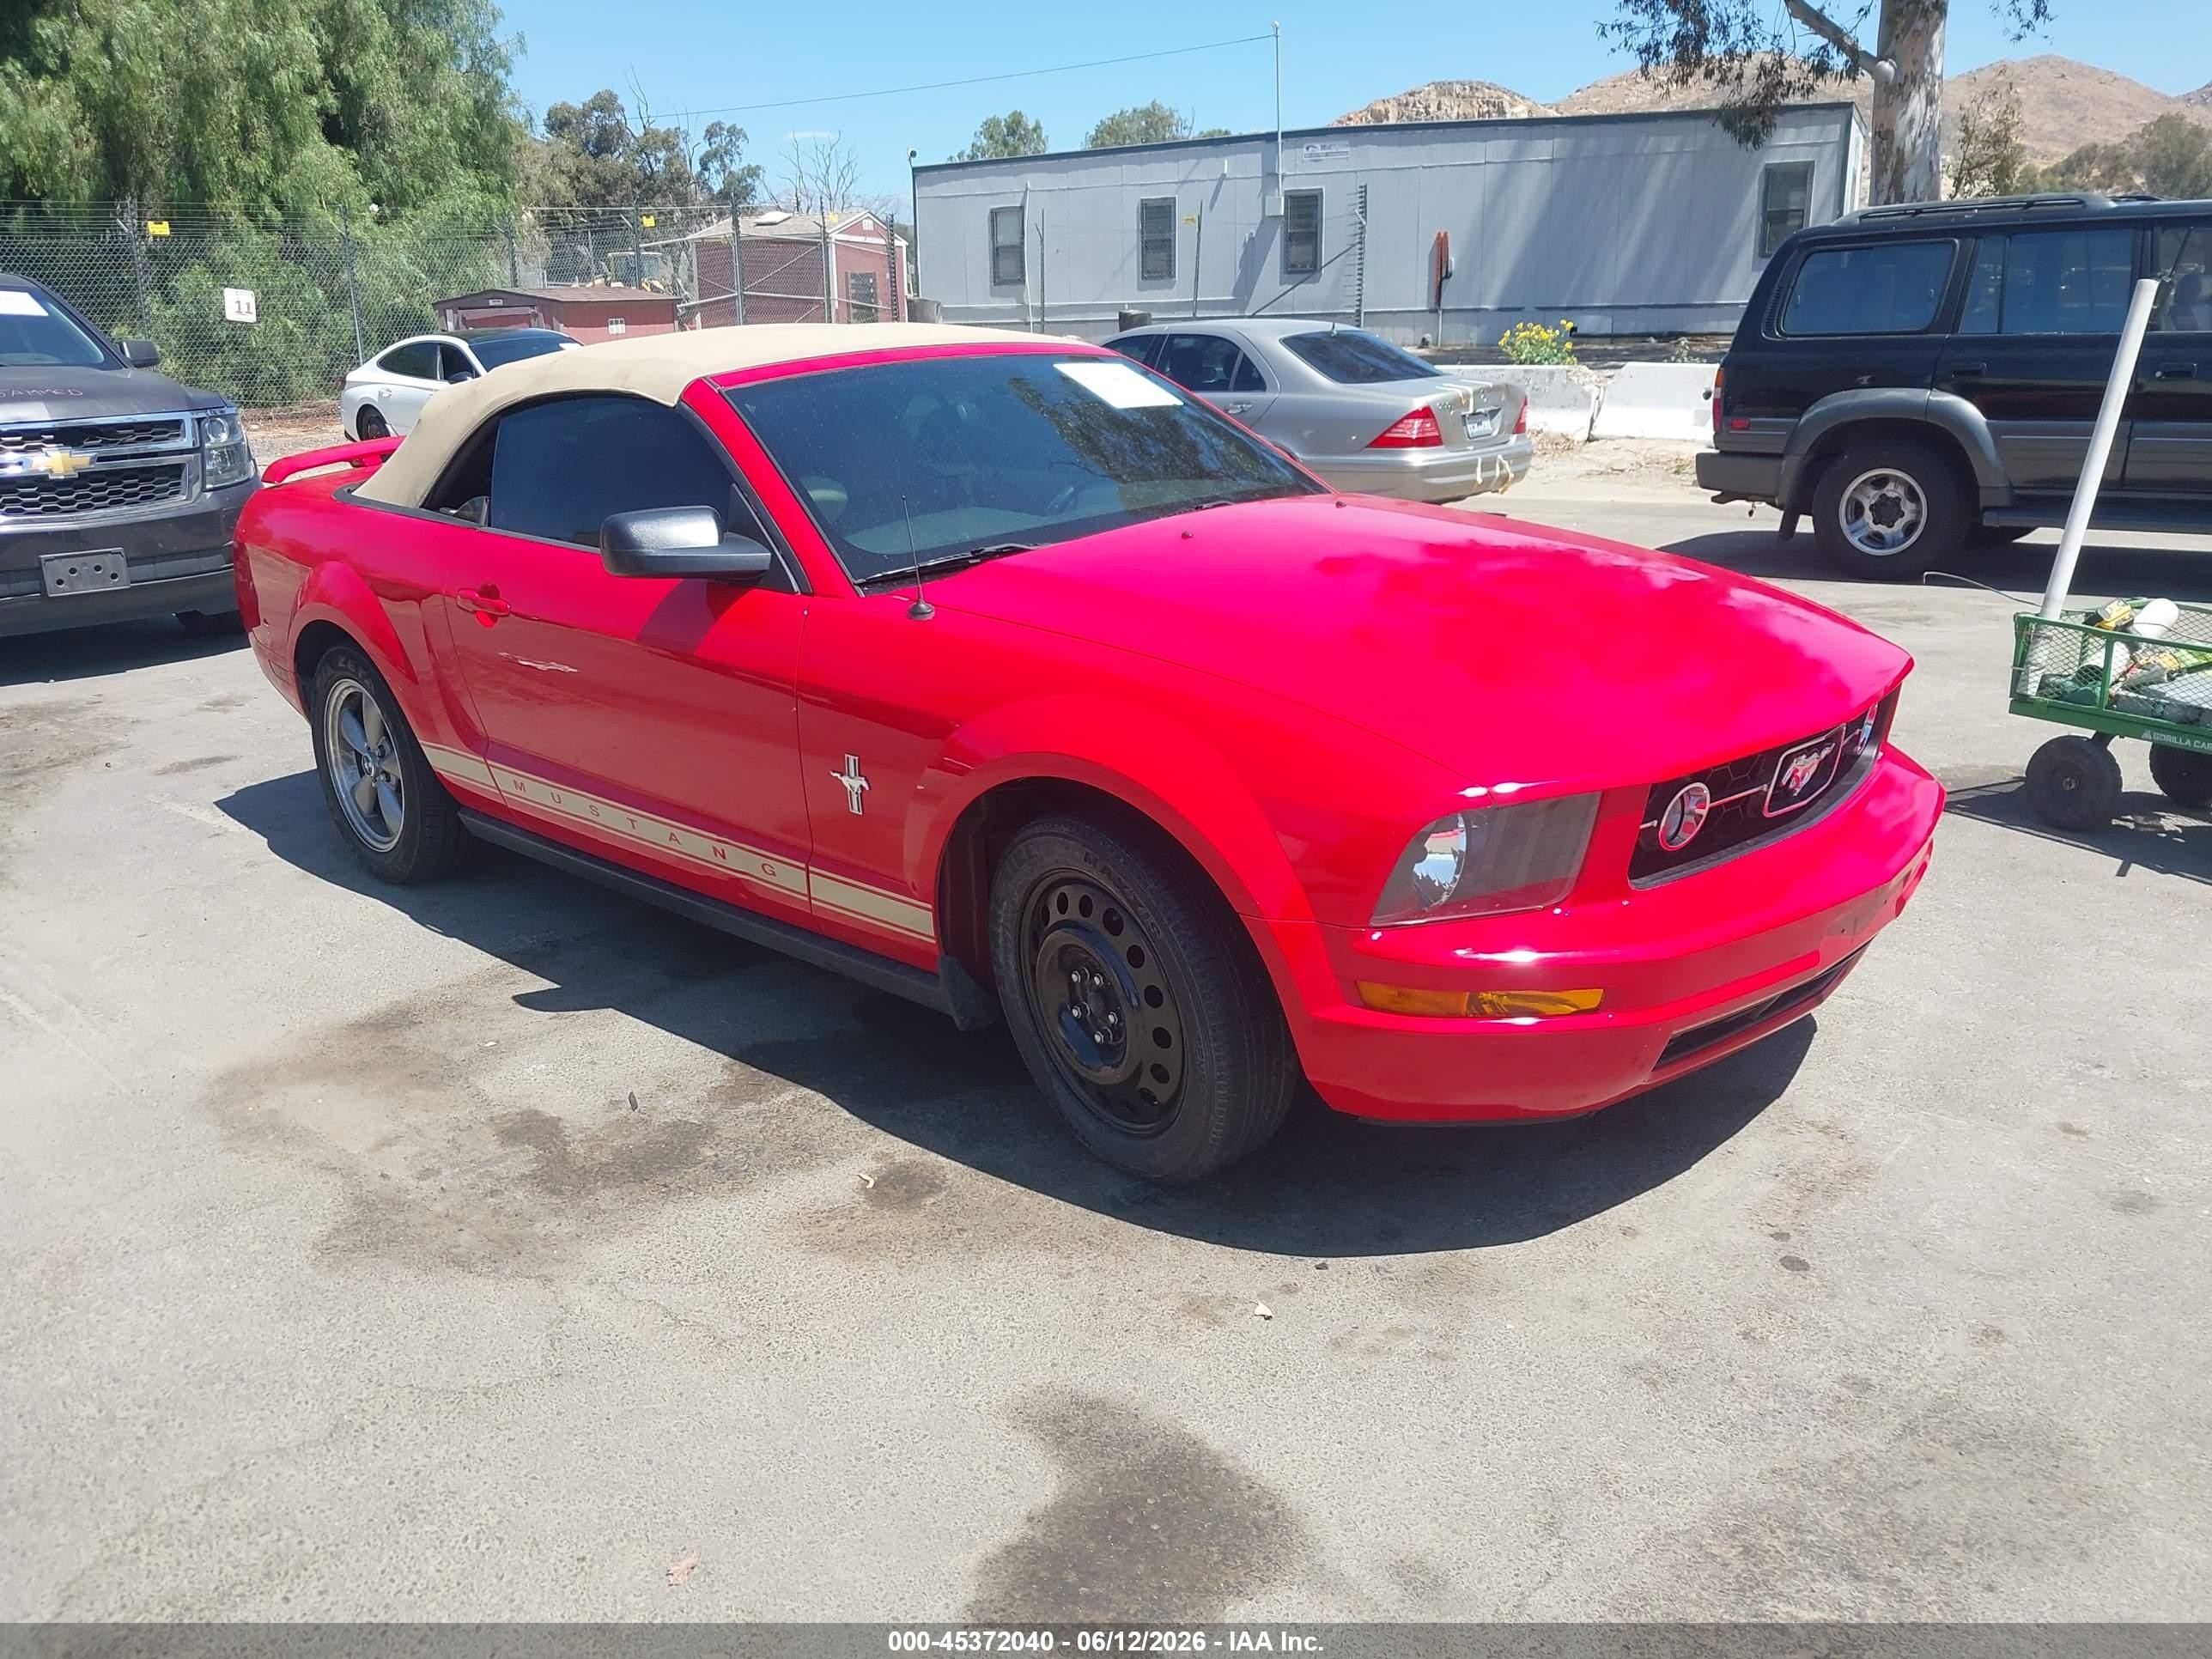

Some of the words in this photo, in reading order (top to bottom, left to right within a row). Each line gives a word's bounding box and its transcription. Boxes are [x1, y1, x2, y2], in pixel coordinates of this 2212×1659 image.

[234, 301, 253, 315] 11
[2153, 732, 2191, 747] GORILLA
[513, 779, 777, 878] MUSTANG
